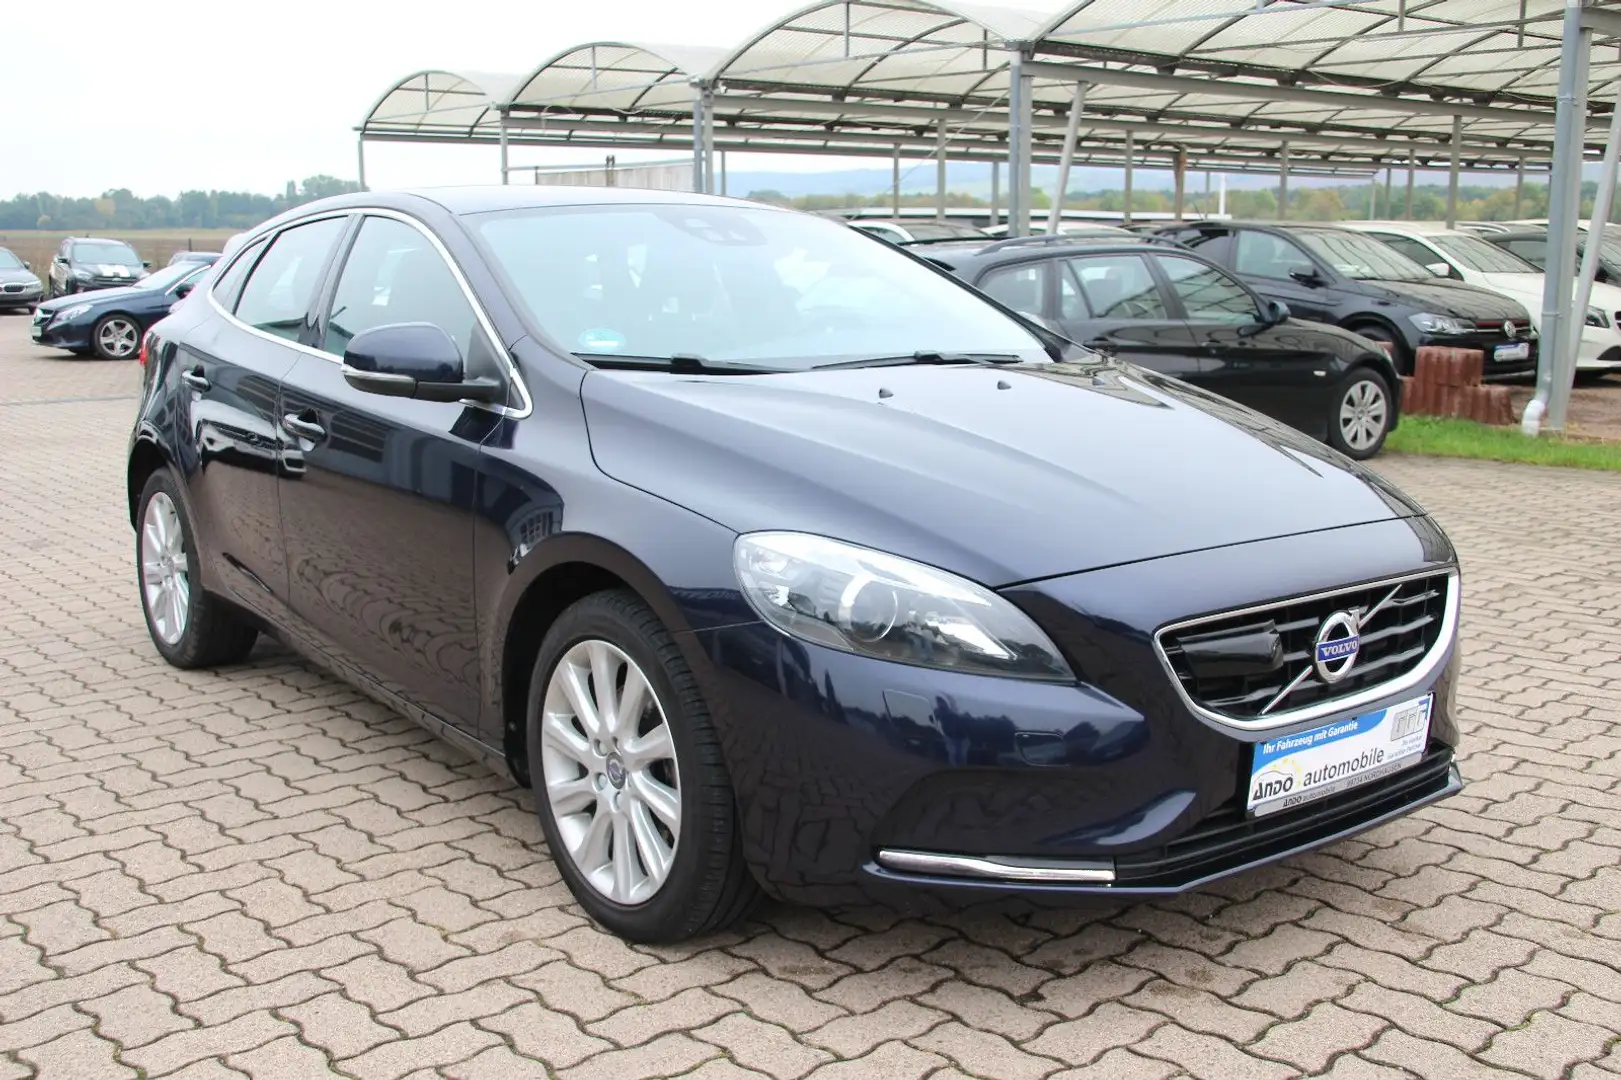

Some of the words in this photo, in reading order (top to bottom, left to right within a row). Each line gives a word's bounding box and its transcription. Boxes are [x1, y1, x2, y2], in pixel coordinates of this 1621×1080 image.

[1321, 640, 1357, 656] VOLVO
[1263, 743, 1276, 754] Ihr
[1276, 735, 1313, 752] Fahrzeug
[1314, 730, 1328, 741] mit
[1328, 721, 1359, 737] Garantie
[1303, 747, 1384, 786] automobile
